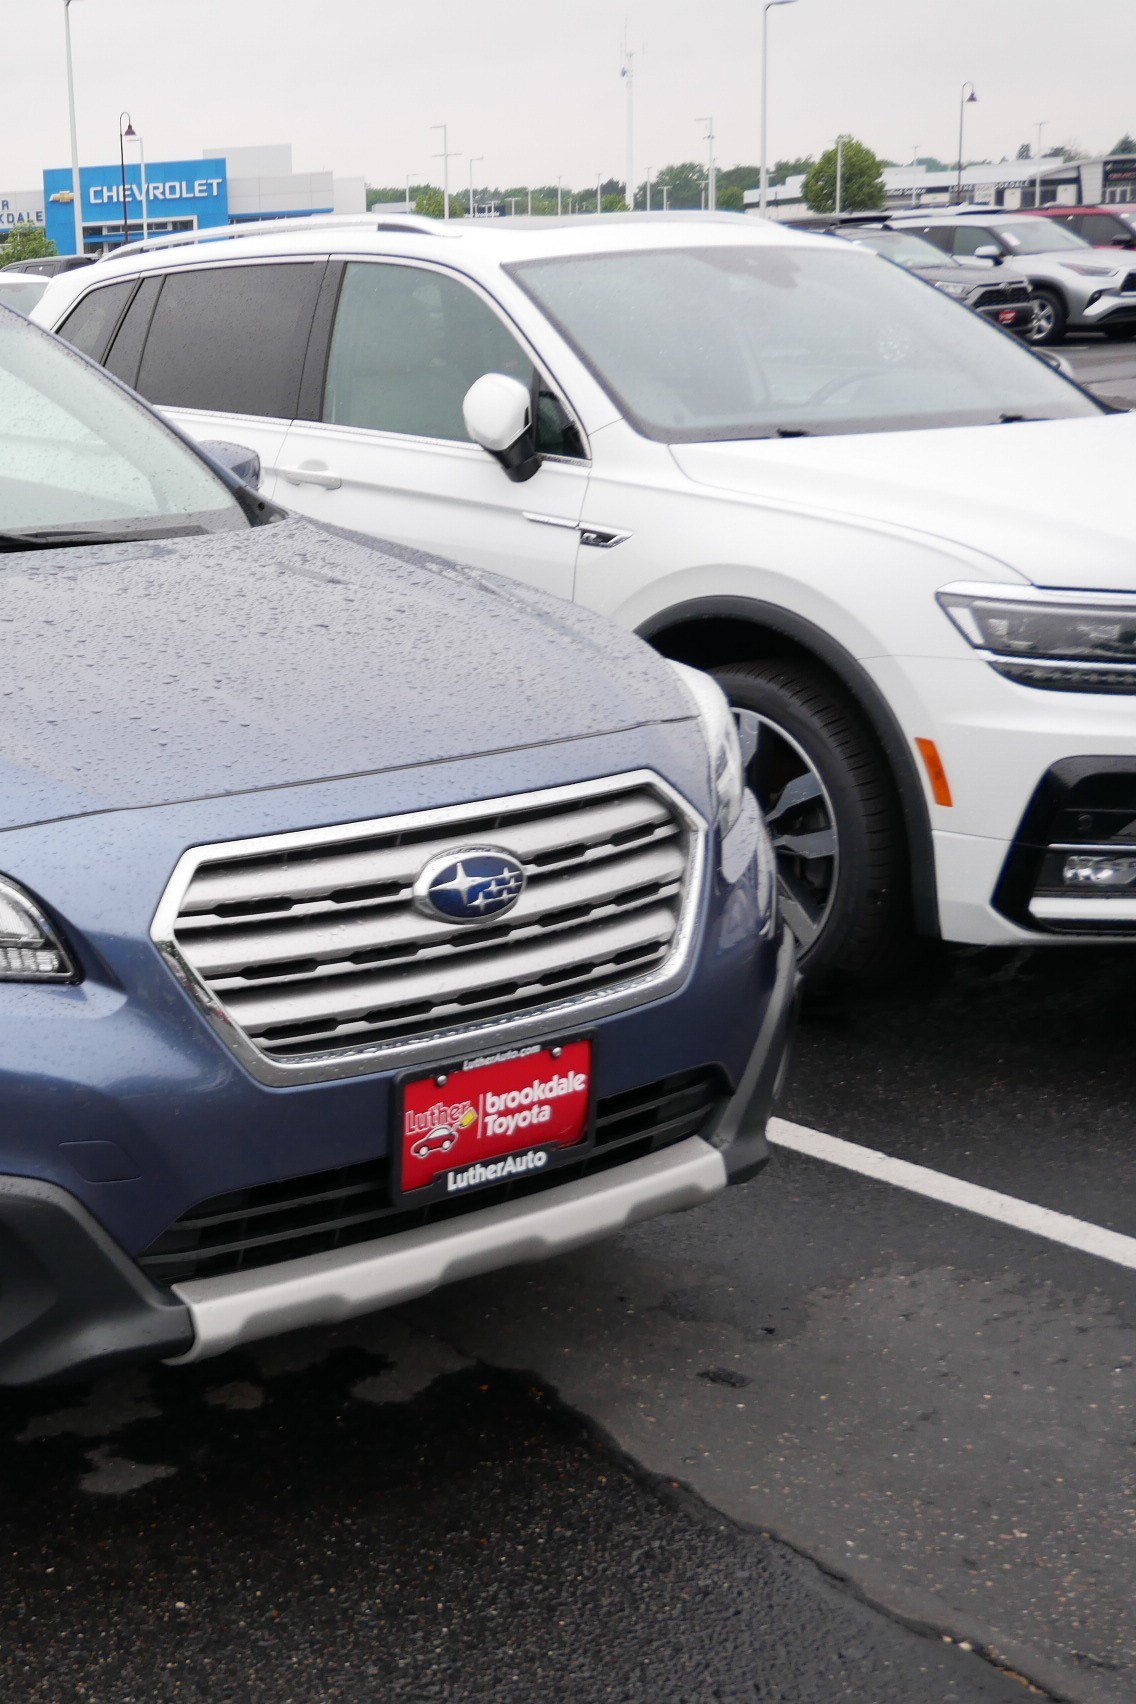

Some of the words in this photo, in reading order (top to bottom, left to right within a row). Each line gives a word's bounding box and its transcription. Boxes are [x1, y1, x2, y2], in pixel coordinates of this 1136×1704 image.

[89, 178, 223, 204] CHEVROLET
[485, 1070, 587, 1113] brookdale
[405, 1100, 471, 1135] Luther
[484, 1104, 551, 1136] Toyota
[447, 1150, 547, 1192] LutherAuto
